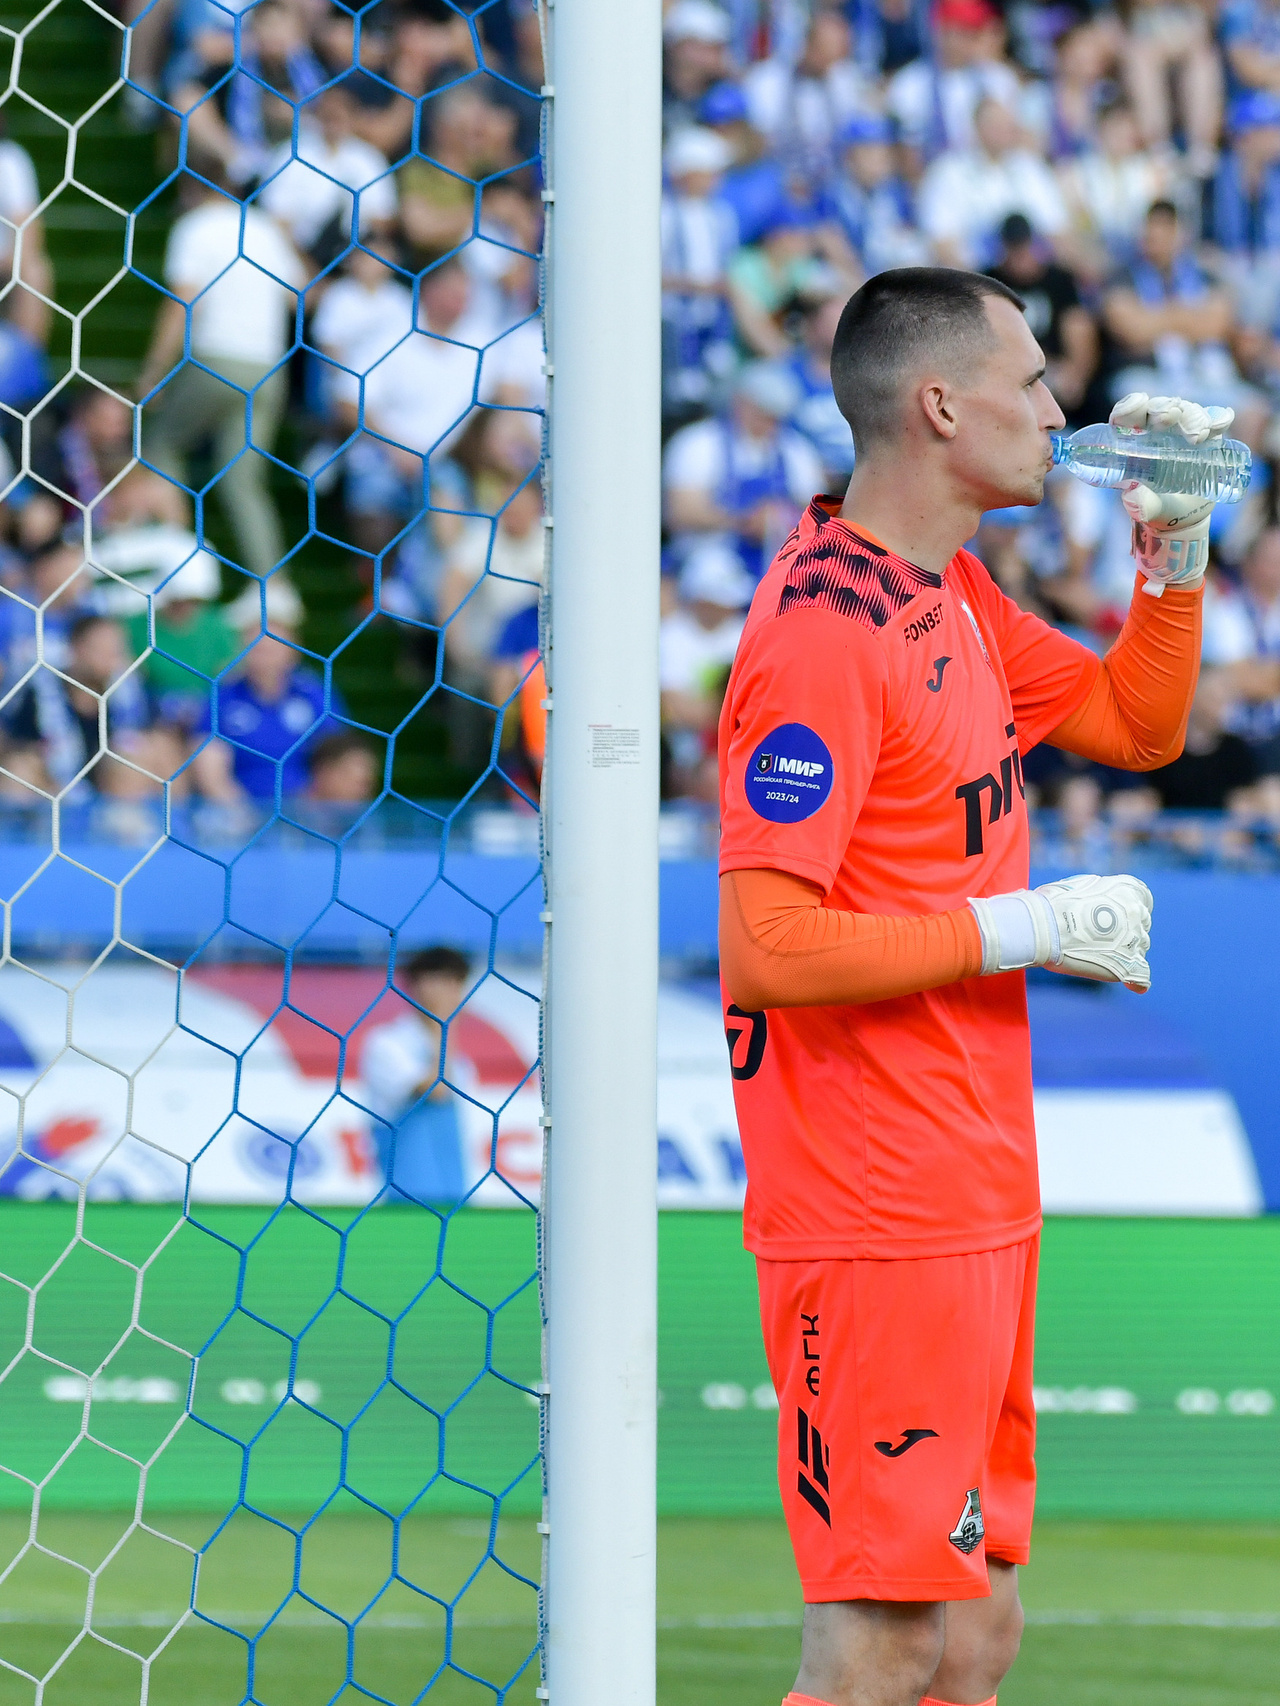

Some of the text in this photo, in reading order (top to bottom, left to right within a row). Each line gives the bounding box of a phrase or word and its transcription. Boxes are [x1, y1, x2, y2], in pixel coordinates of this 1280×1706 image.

[903, 602, 944, 647] FONBET
[778, 757, 825, 777] МИР
[765, 791, 799, 804] 2023/24
